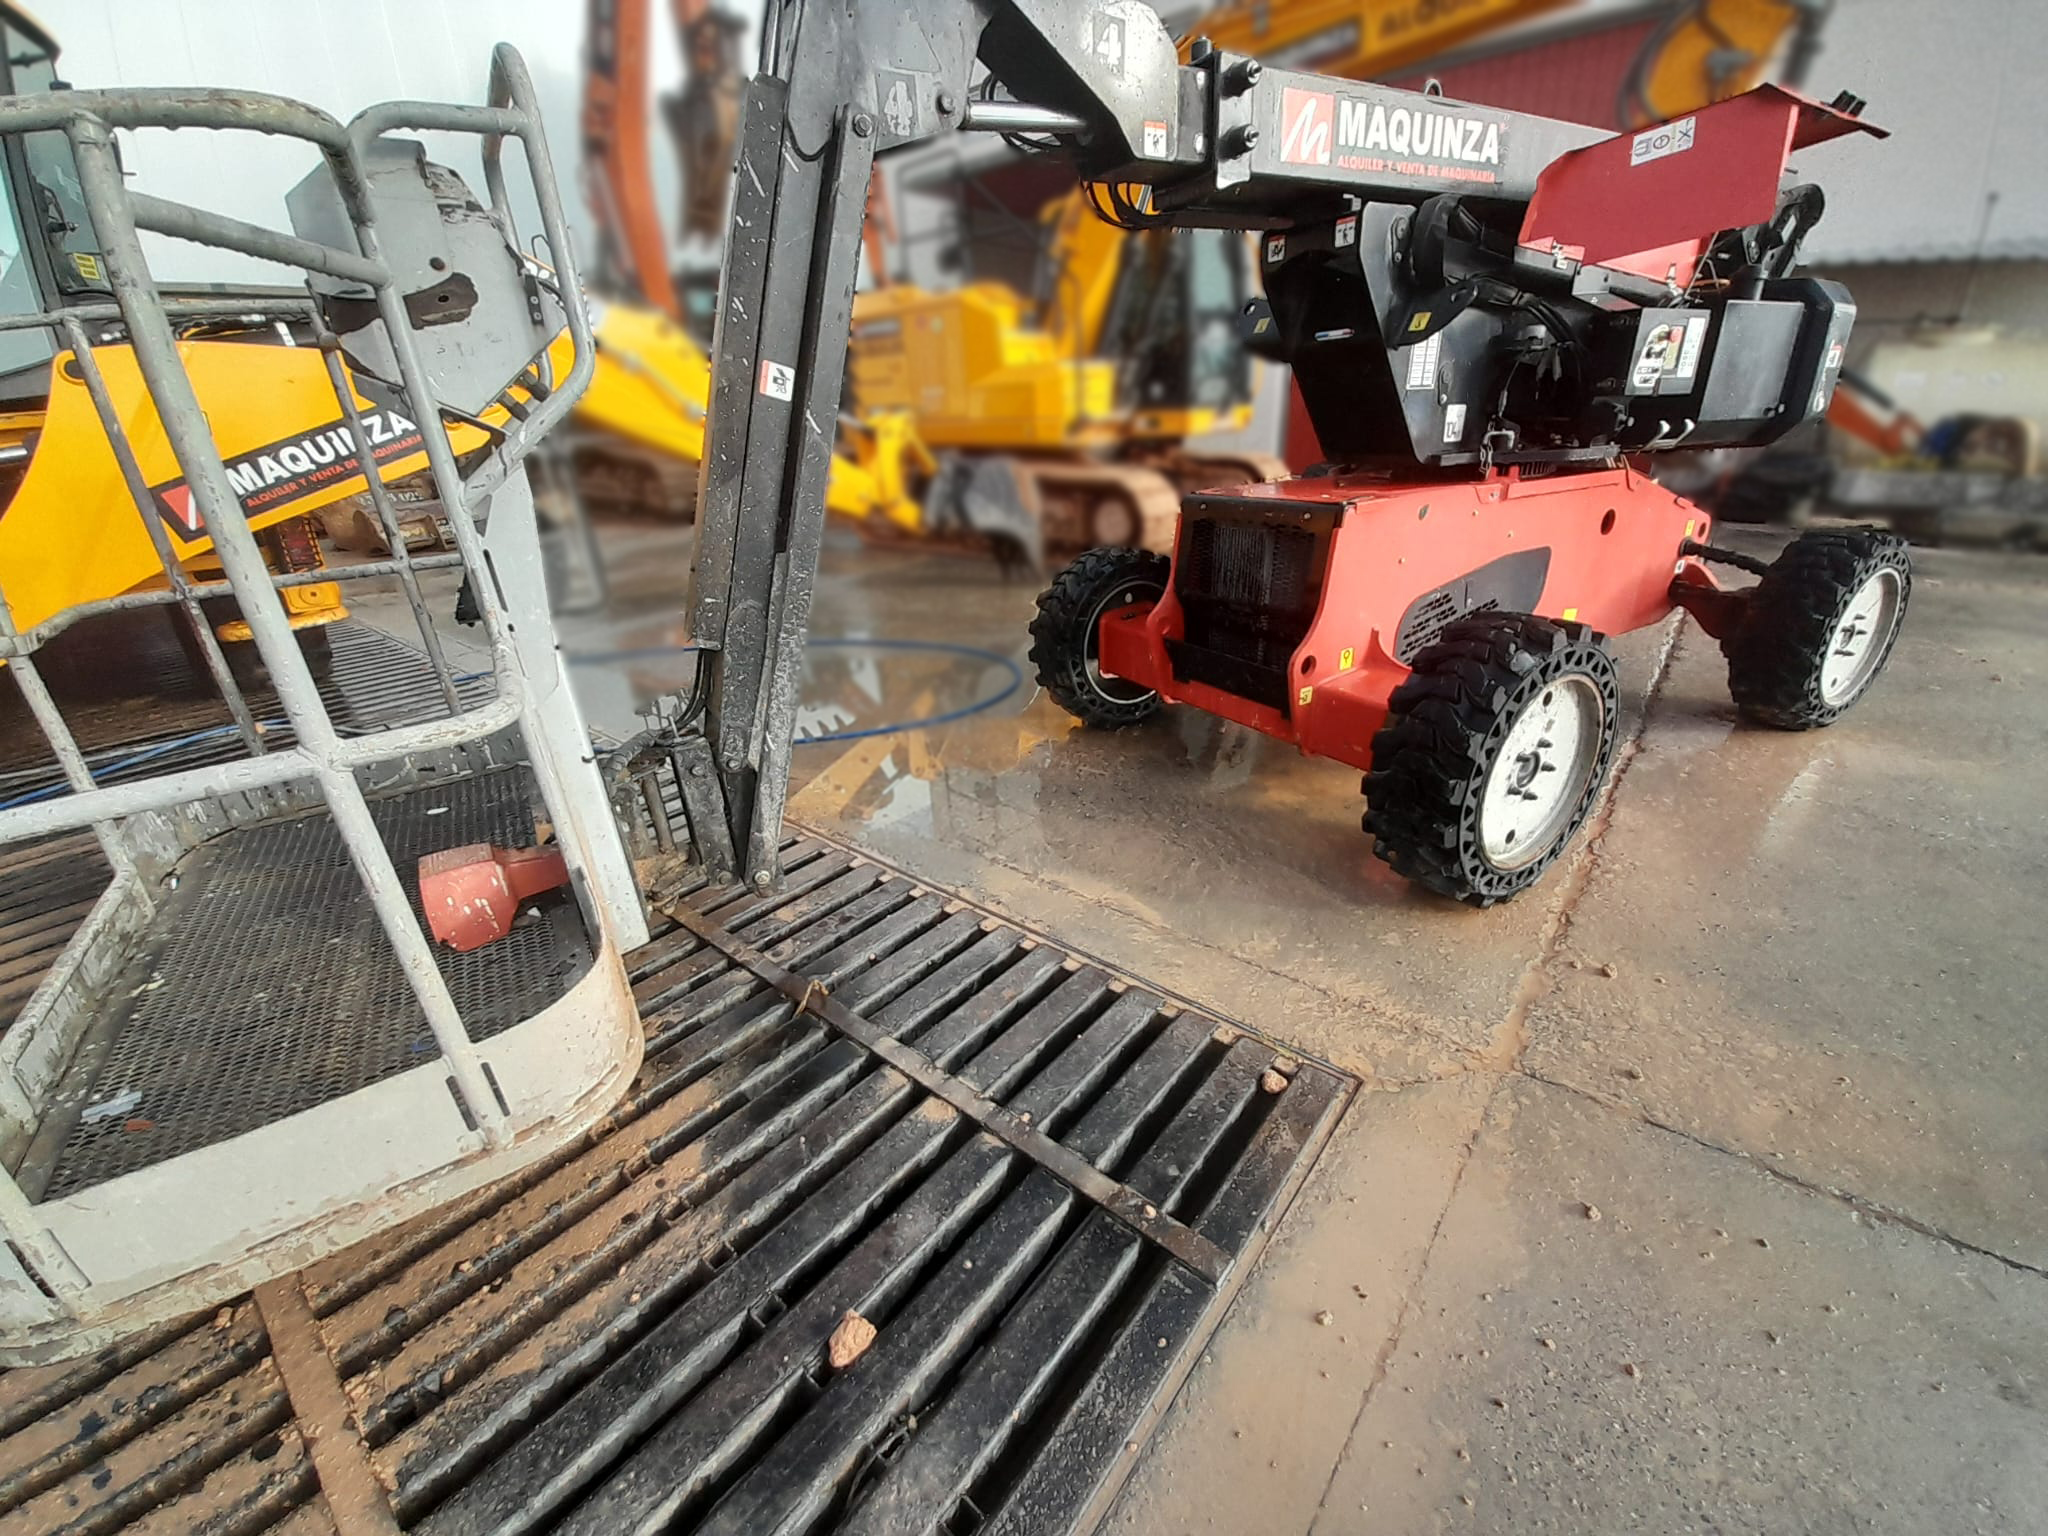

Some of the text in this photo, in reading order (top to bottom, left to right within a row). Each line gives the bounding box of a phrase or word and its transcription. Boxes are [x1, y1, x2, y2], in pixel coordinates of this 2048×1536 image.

[1338, 99, 1499, 164] MAQUINZA
[1336, 154, 1384, 171] ALQUILER
[1396, 160, 1425, 175] VENTA
[1427, 164, 1438, 177] DE
[245, 481, 300, 507] ALQUILER
[308, 464, 346, 483] VENTA
